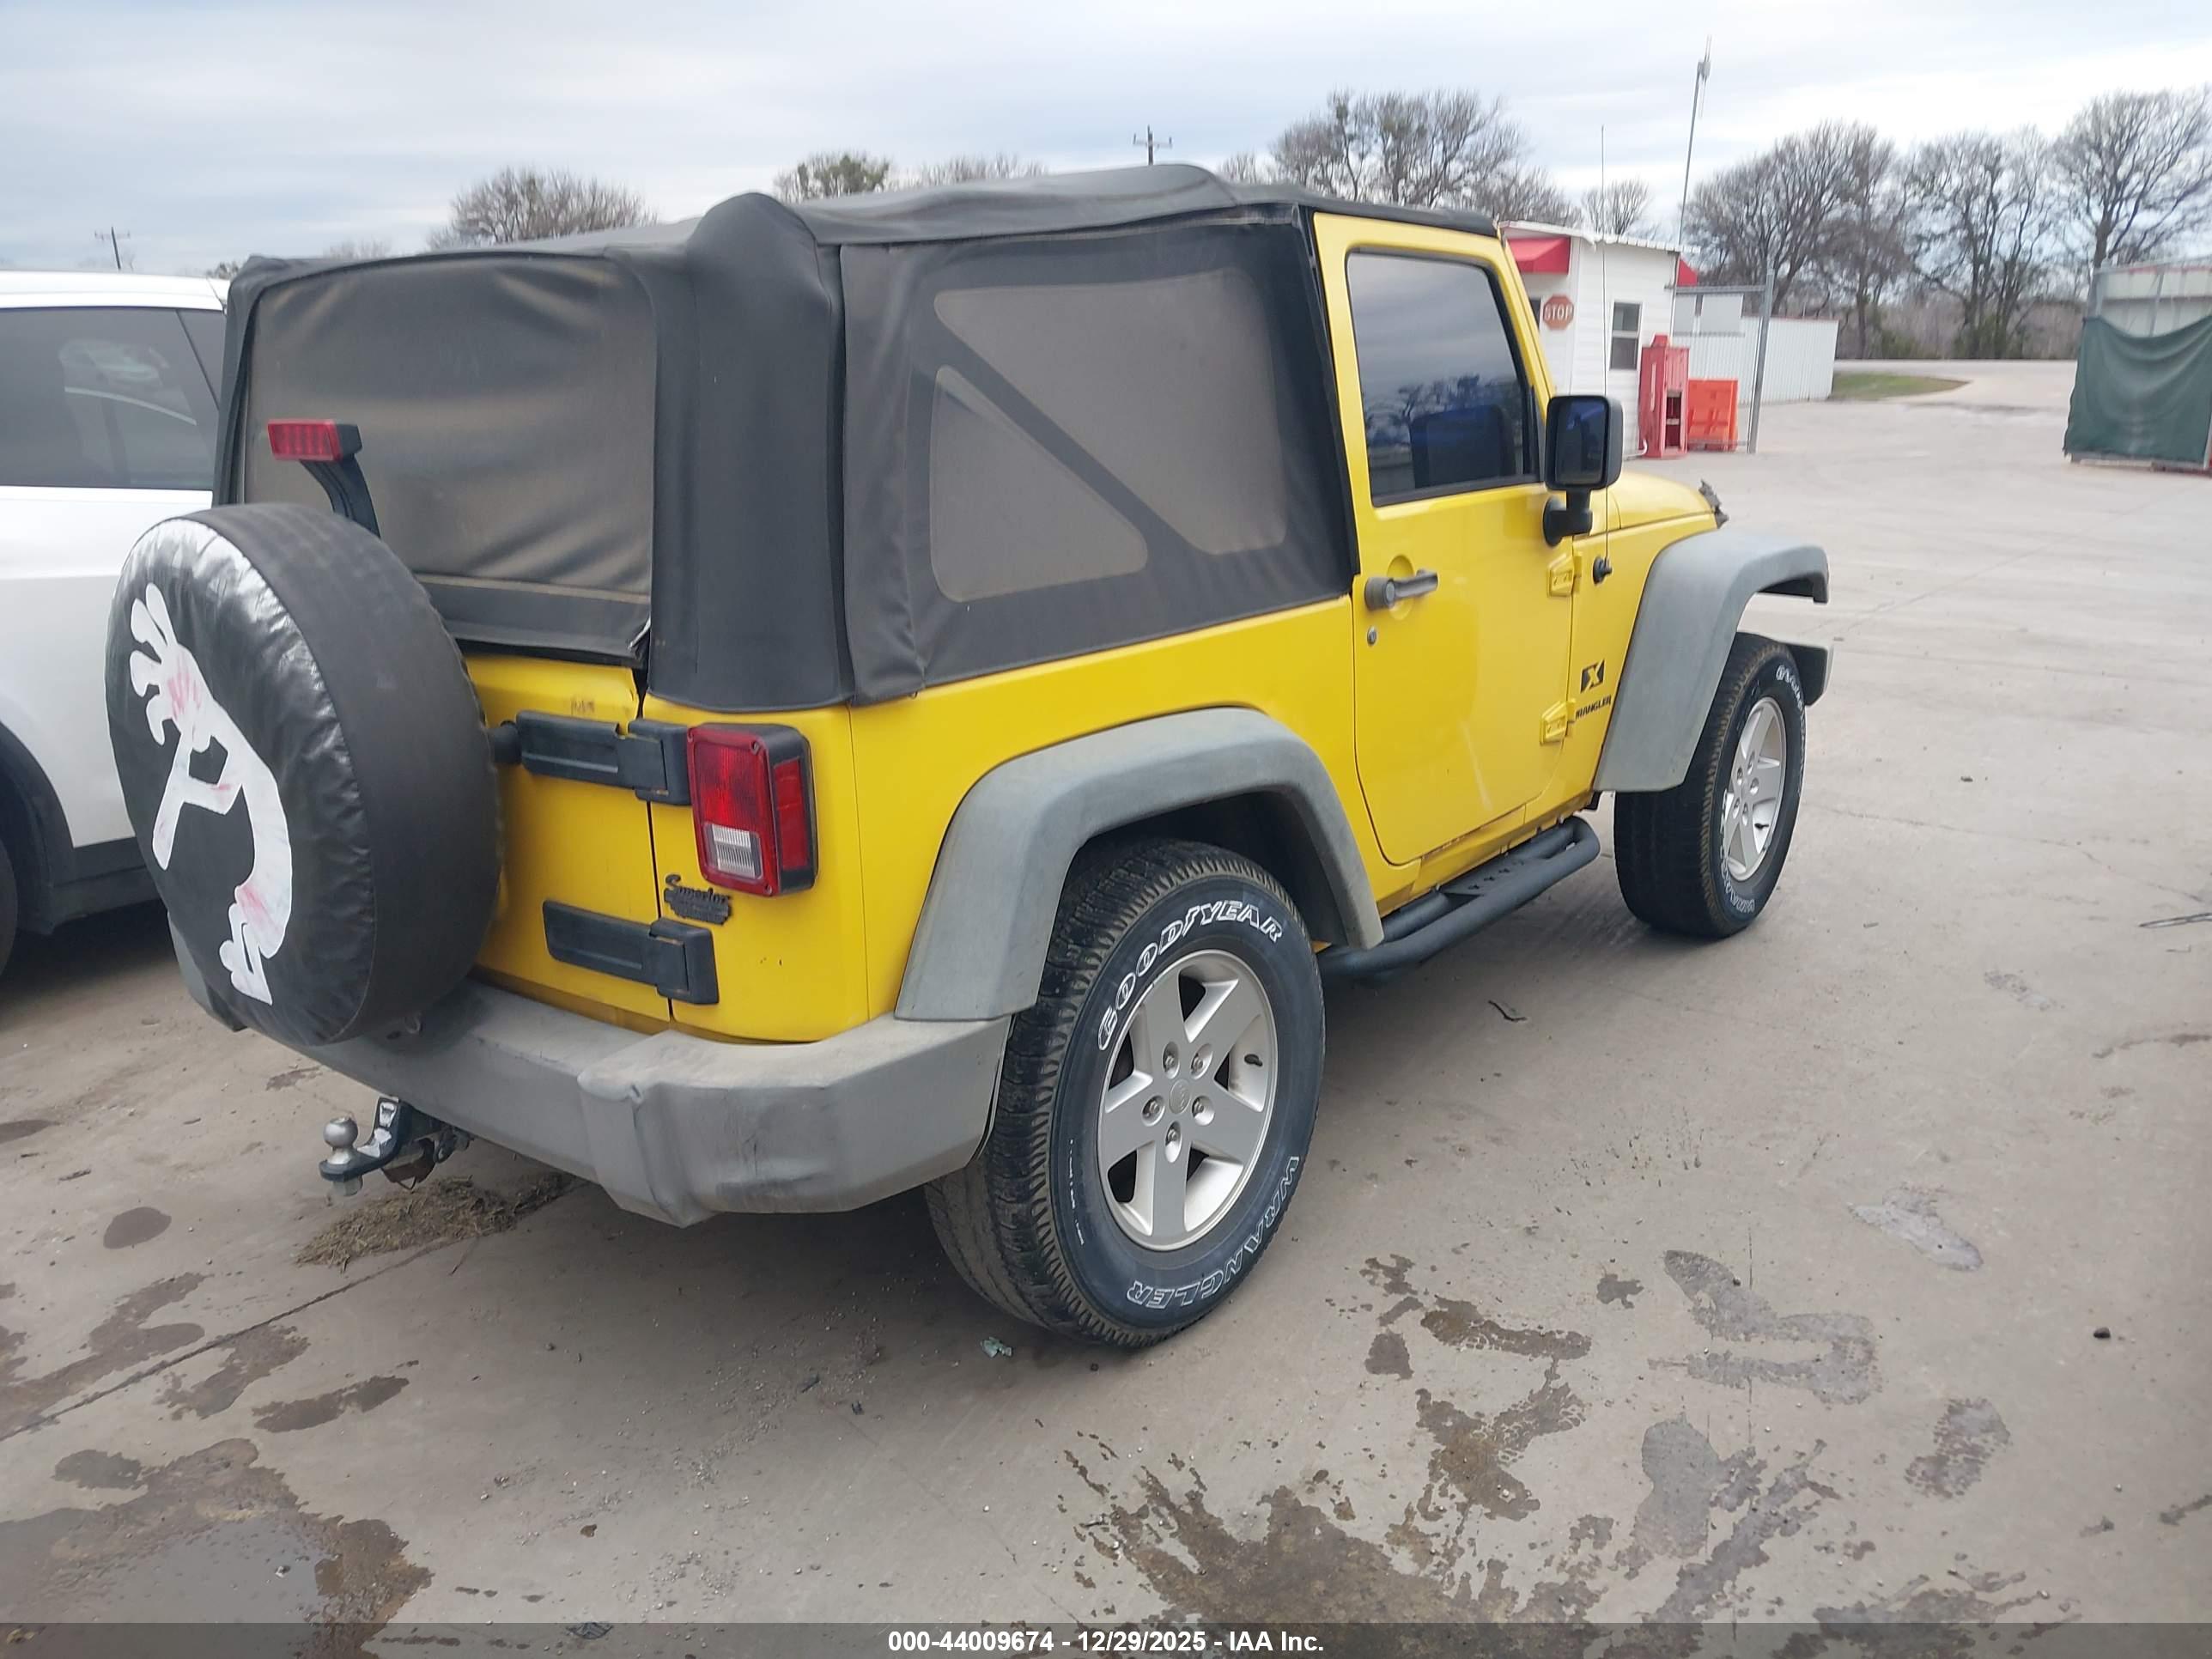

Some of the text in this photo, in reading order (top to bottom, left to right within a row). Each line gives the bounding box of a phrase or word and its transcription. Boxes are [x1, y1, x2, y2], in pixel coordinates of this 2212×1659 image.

[1544, 301, 1573, 320] STOP
[1580, 659, 1605, 694] X
[1098, 899, 1284, 1051] GOODYEAR
[1126, 1156, 1300, 1310] WRANGLER
